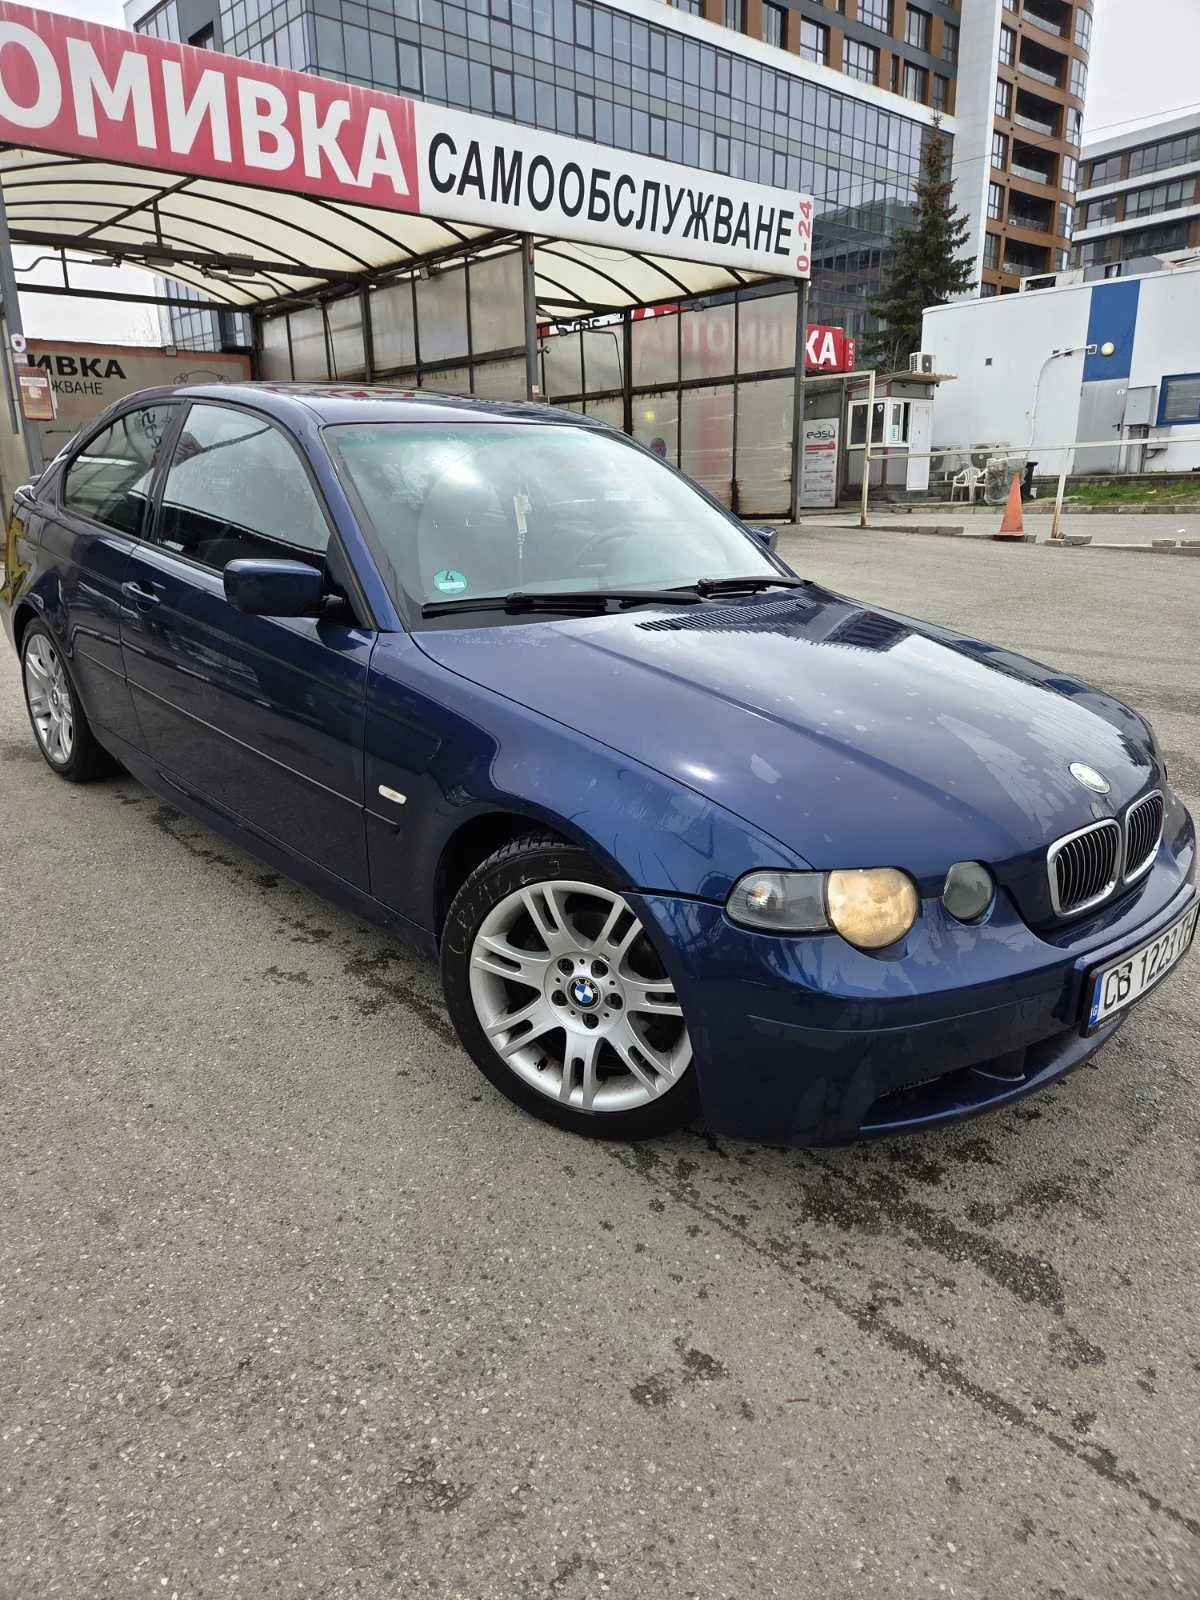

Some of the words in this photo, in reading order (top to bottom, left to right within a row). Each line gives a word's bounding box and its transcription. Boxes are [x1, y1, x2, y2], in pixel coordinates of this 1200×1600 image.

[0, 21, 410, 196] ОМИВКА
[428, 132, 795, 256] САМООБСЛУЖВАНЕ
[796, 201, 812, 272] 0-24
[445, 571, 454, 582] 4
[1141, 927, 1178, 988] 1223
